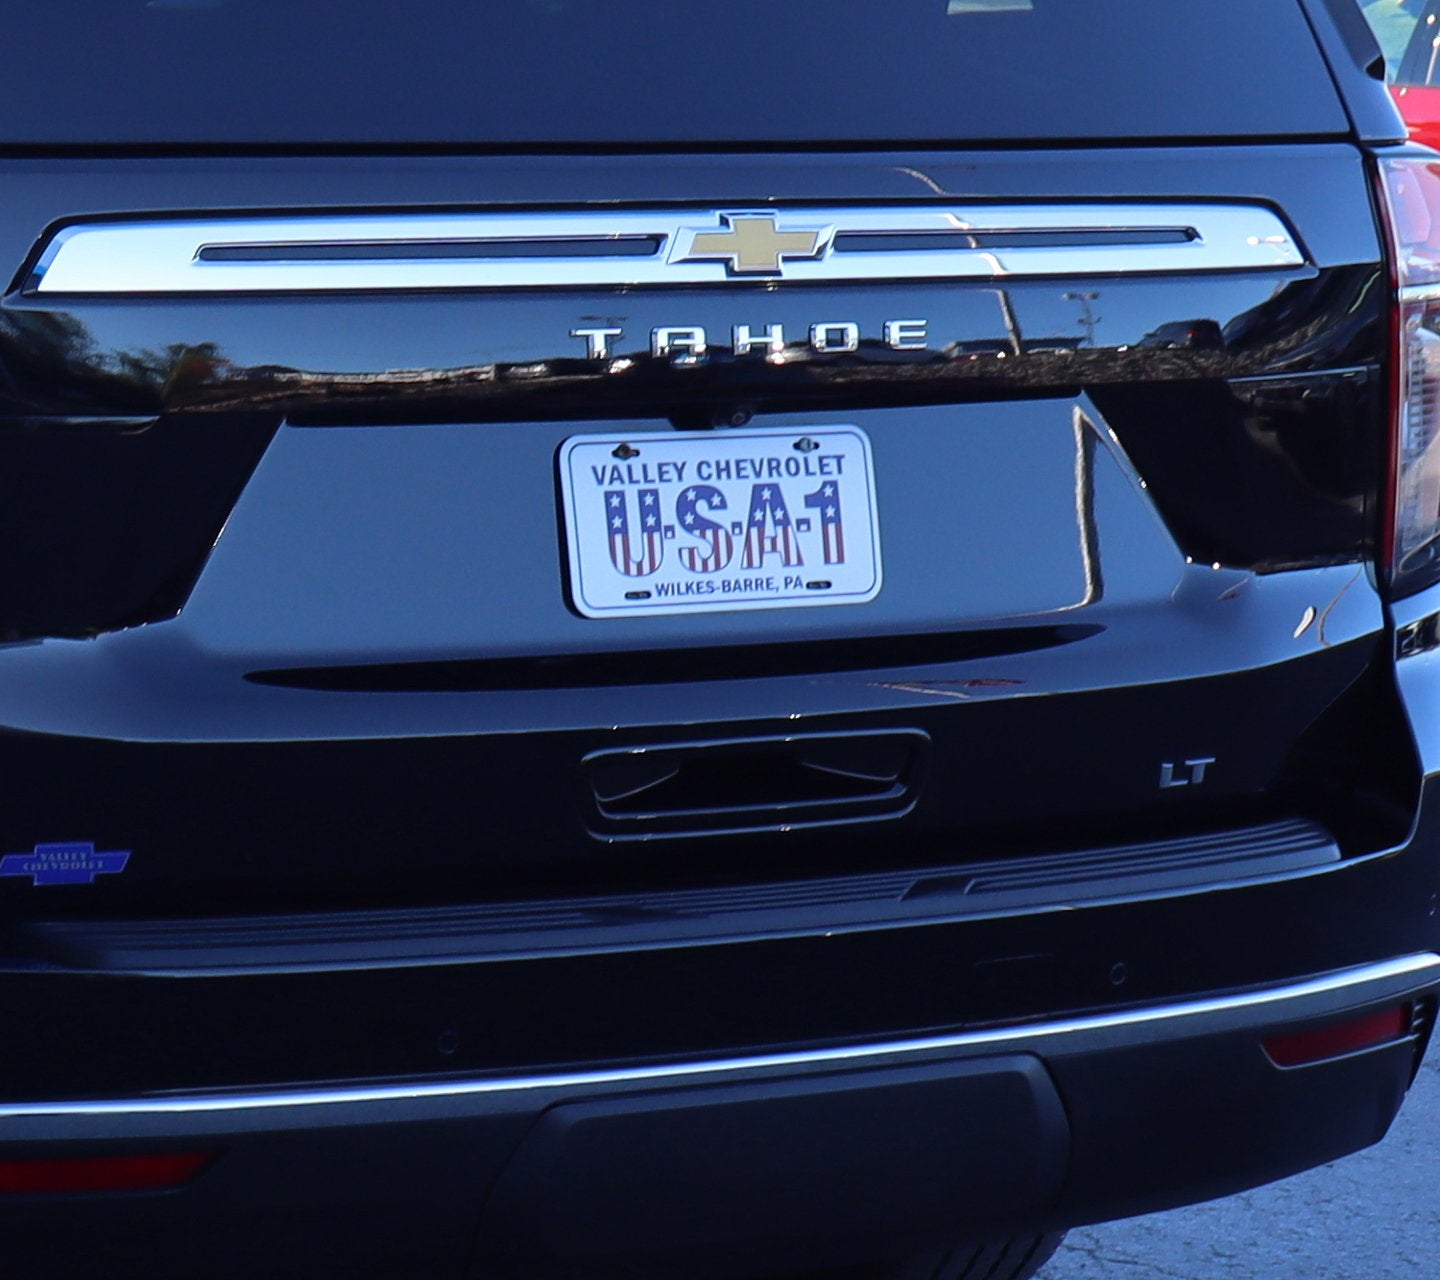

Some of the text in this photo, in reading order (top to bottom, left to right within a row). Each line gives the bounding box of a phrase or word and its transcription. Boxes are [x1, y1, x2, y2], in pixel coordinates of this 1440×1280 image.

[569, 319, 929, 361] TAHOE
[591, 454, 846, 486] VALLEY CHEVROLET
[655, 576, 804, 598] WILKES-BARRE, PA
[1159, 757, 1216, 788] LT
